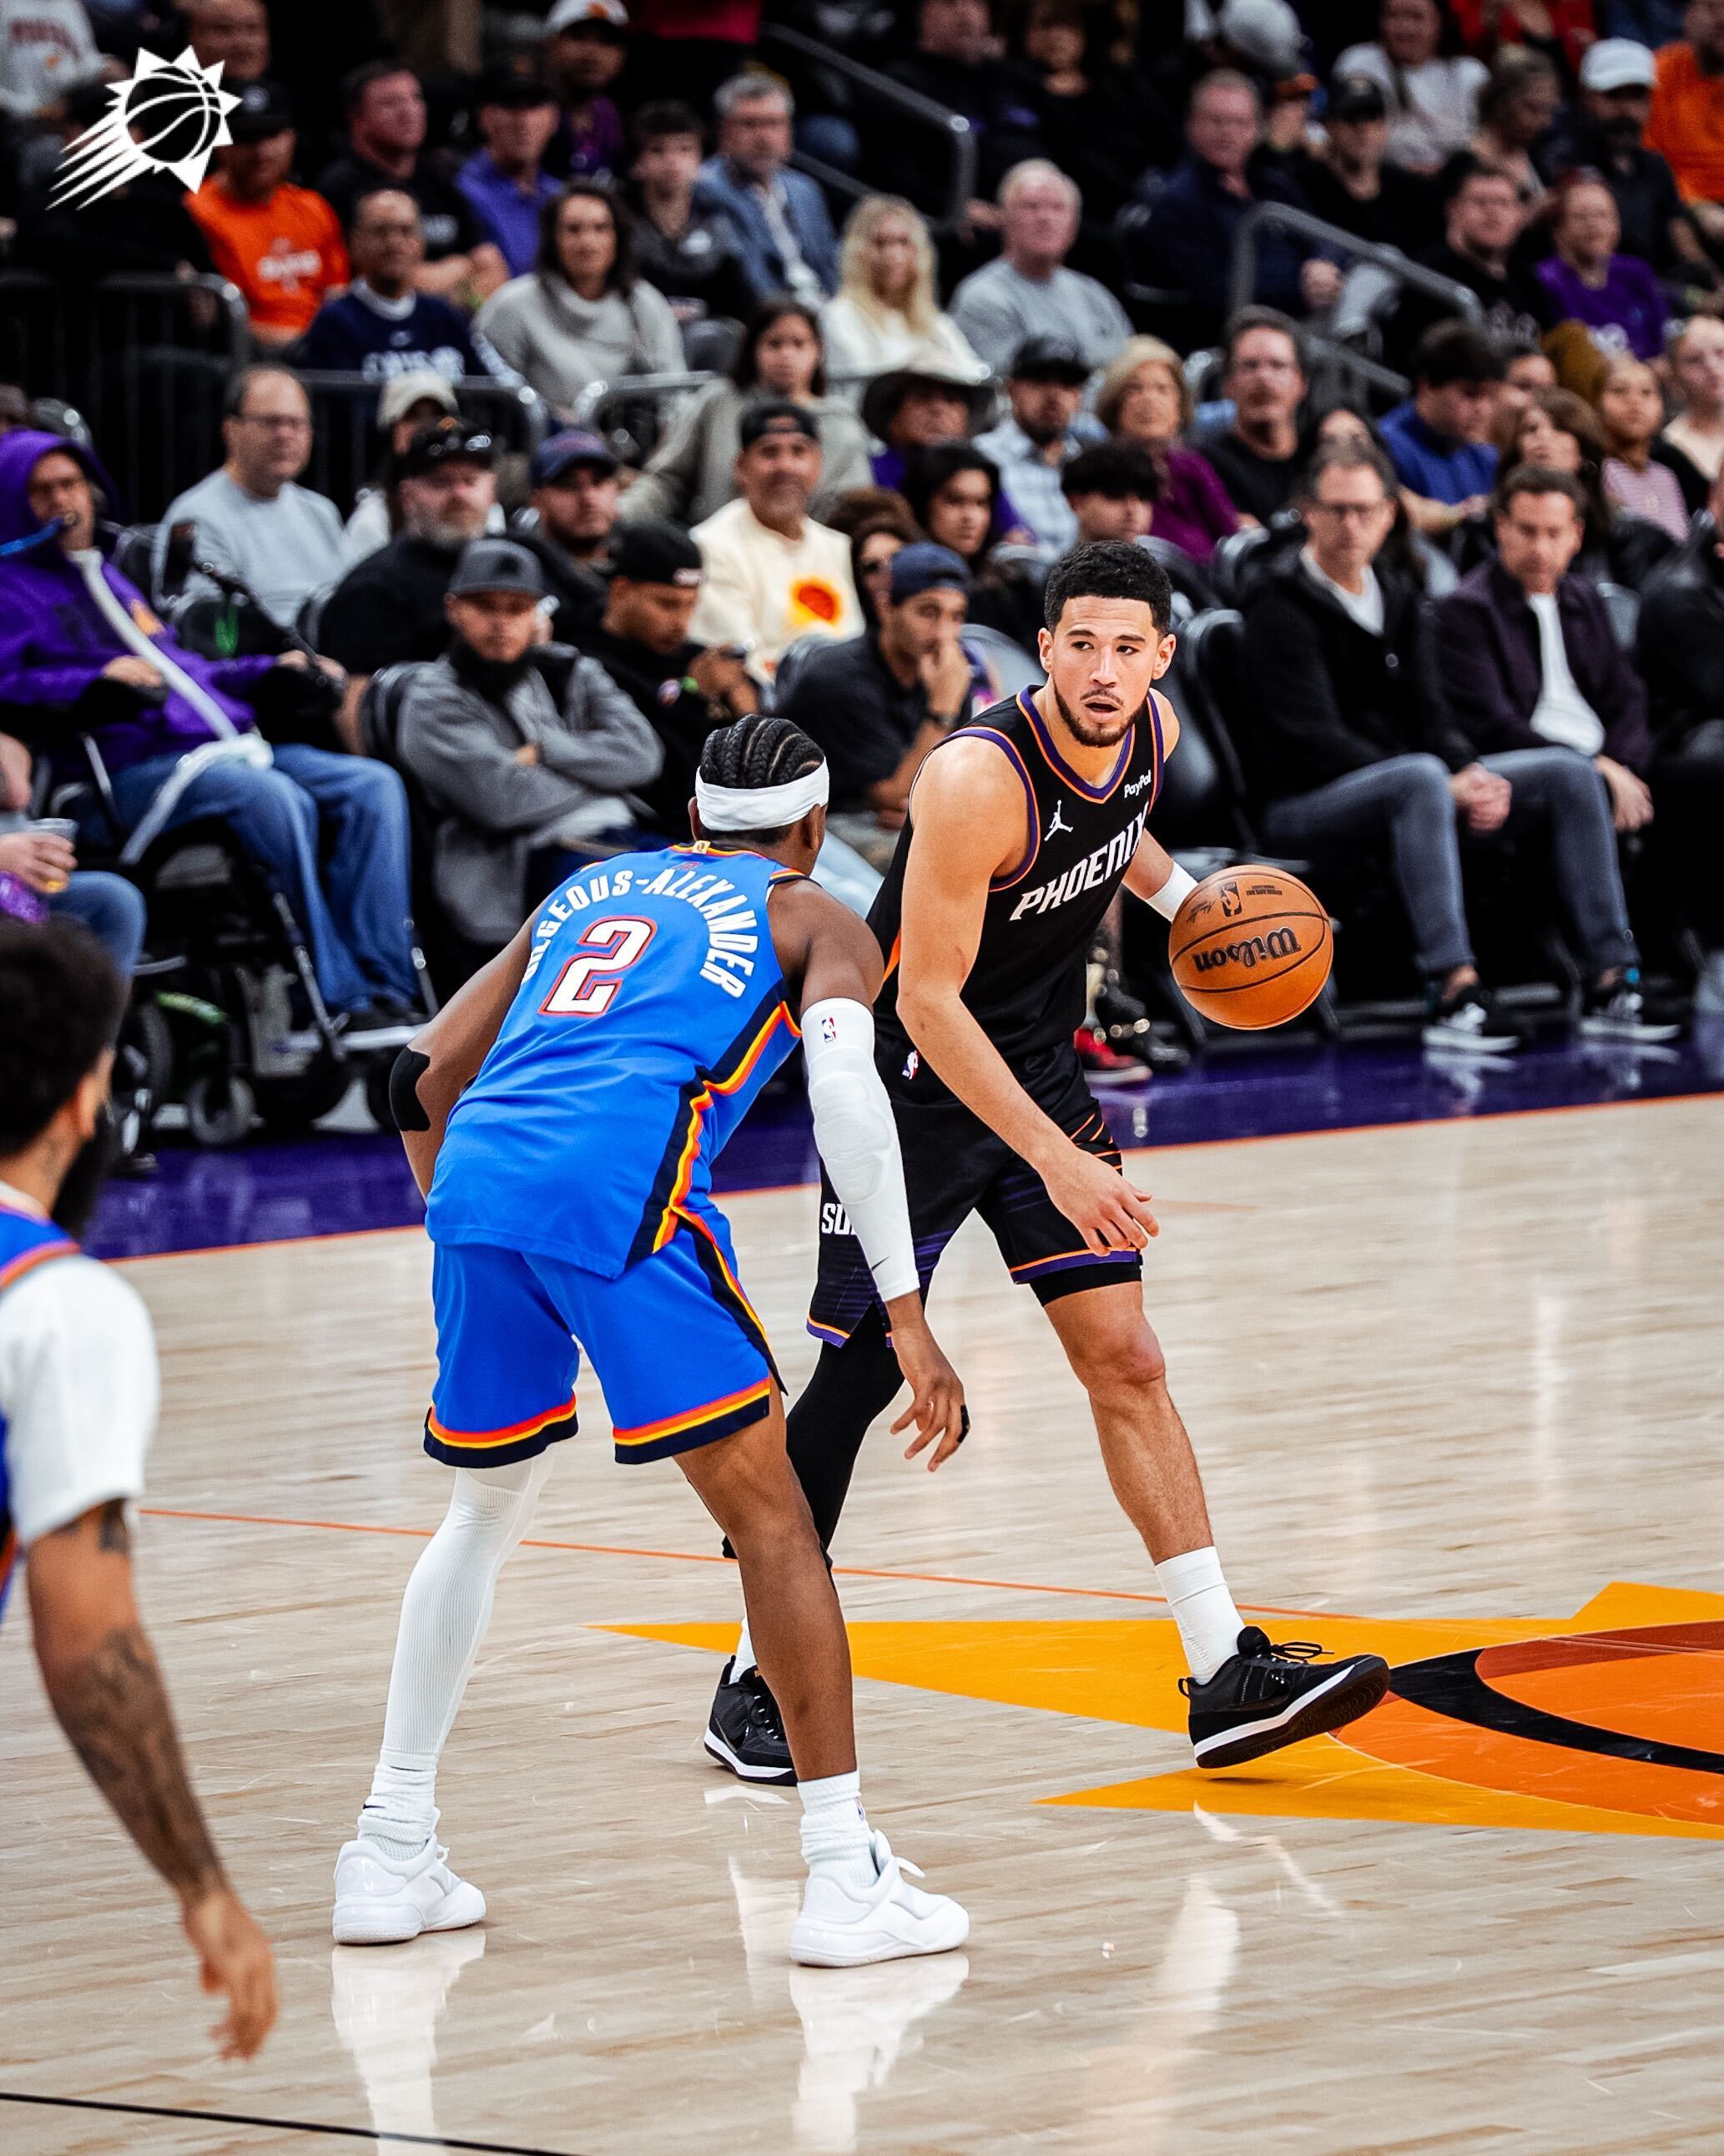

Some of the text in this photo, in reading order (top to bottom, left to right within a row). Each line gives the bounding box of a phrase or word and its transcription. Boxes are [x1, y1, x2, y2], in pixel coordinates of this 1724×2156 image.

[1124, 770, 1152, 798] PayPal
[538, 915, 658, 1017] 2
[1192, 926, 1302, 973] Wilson
[821, 1203, 856, 1235] SU
